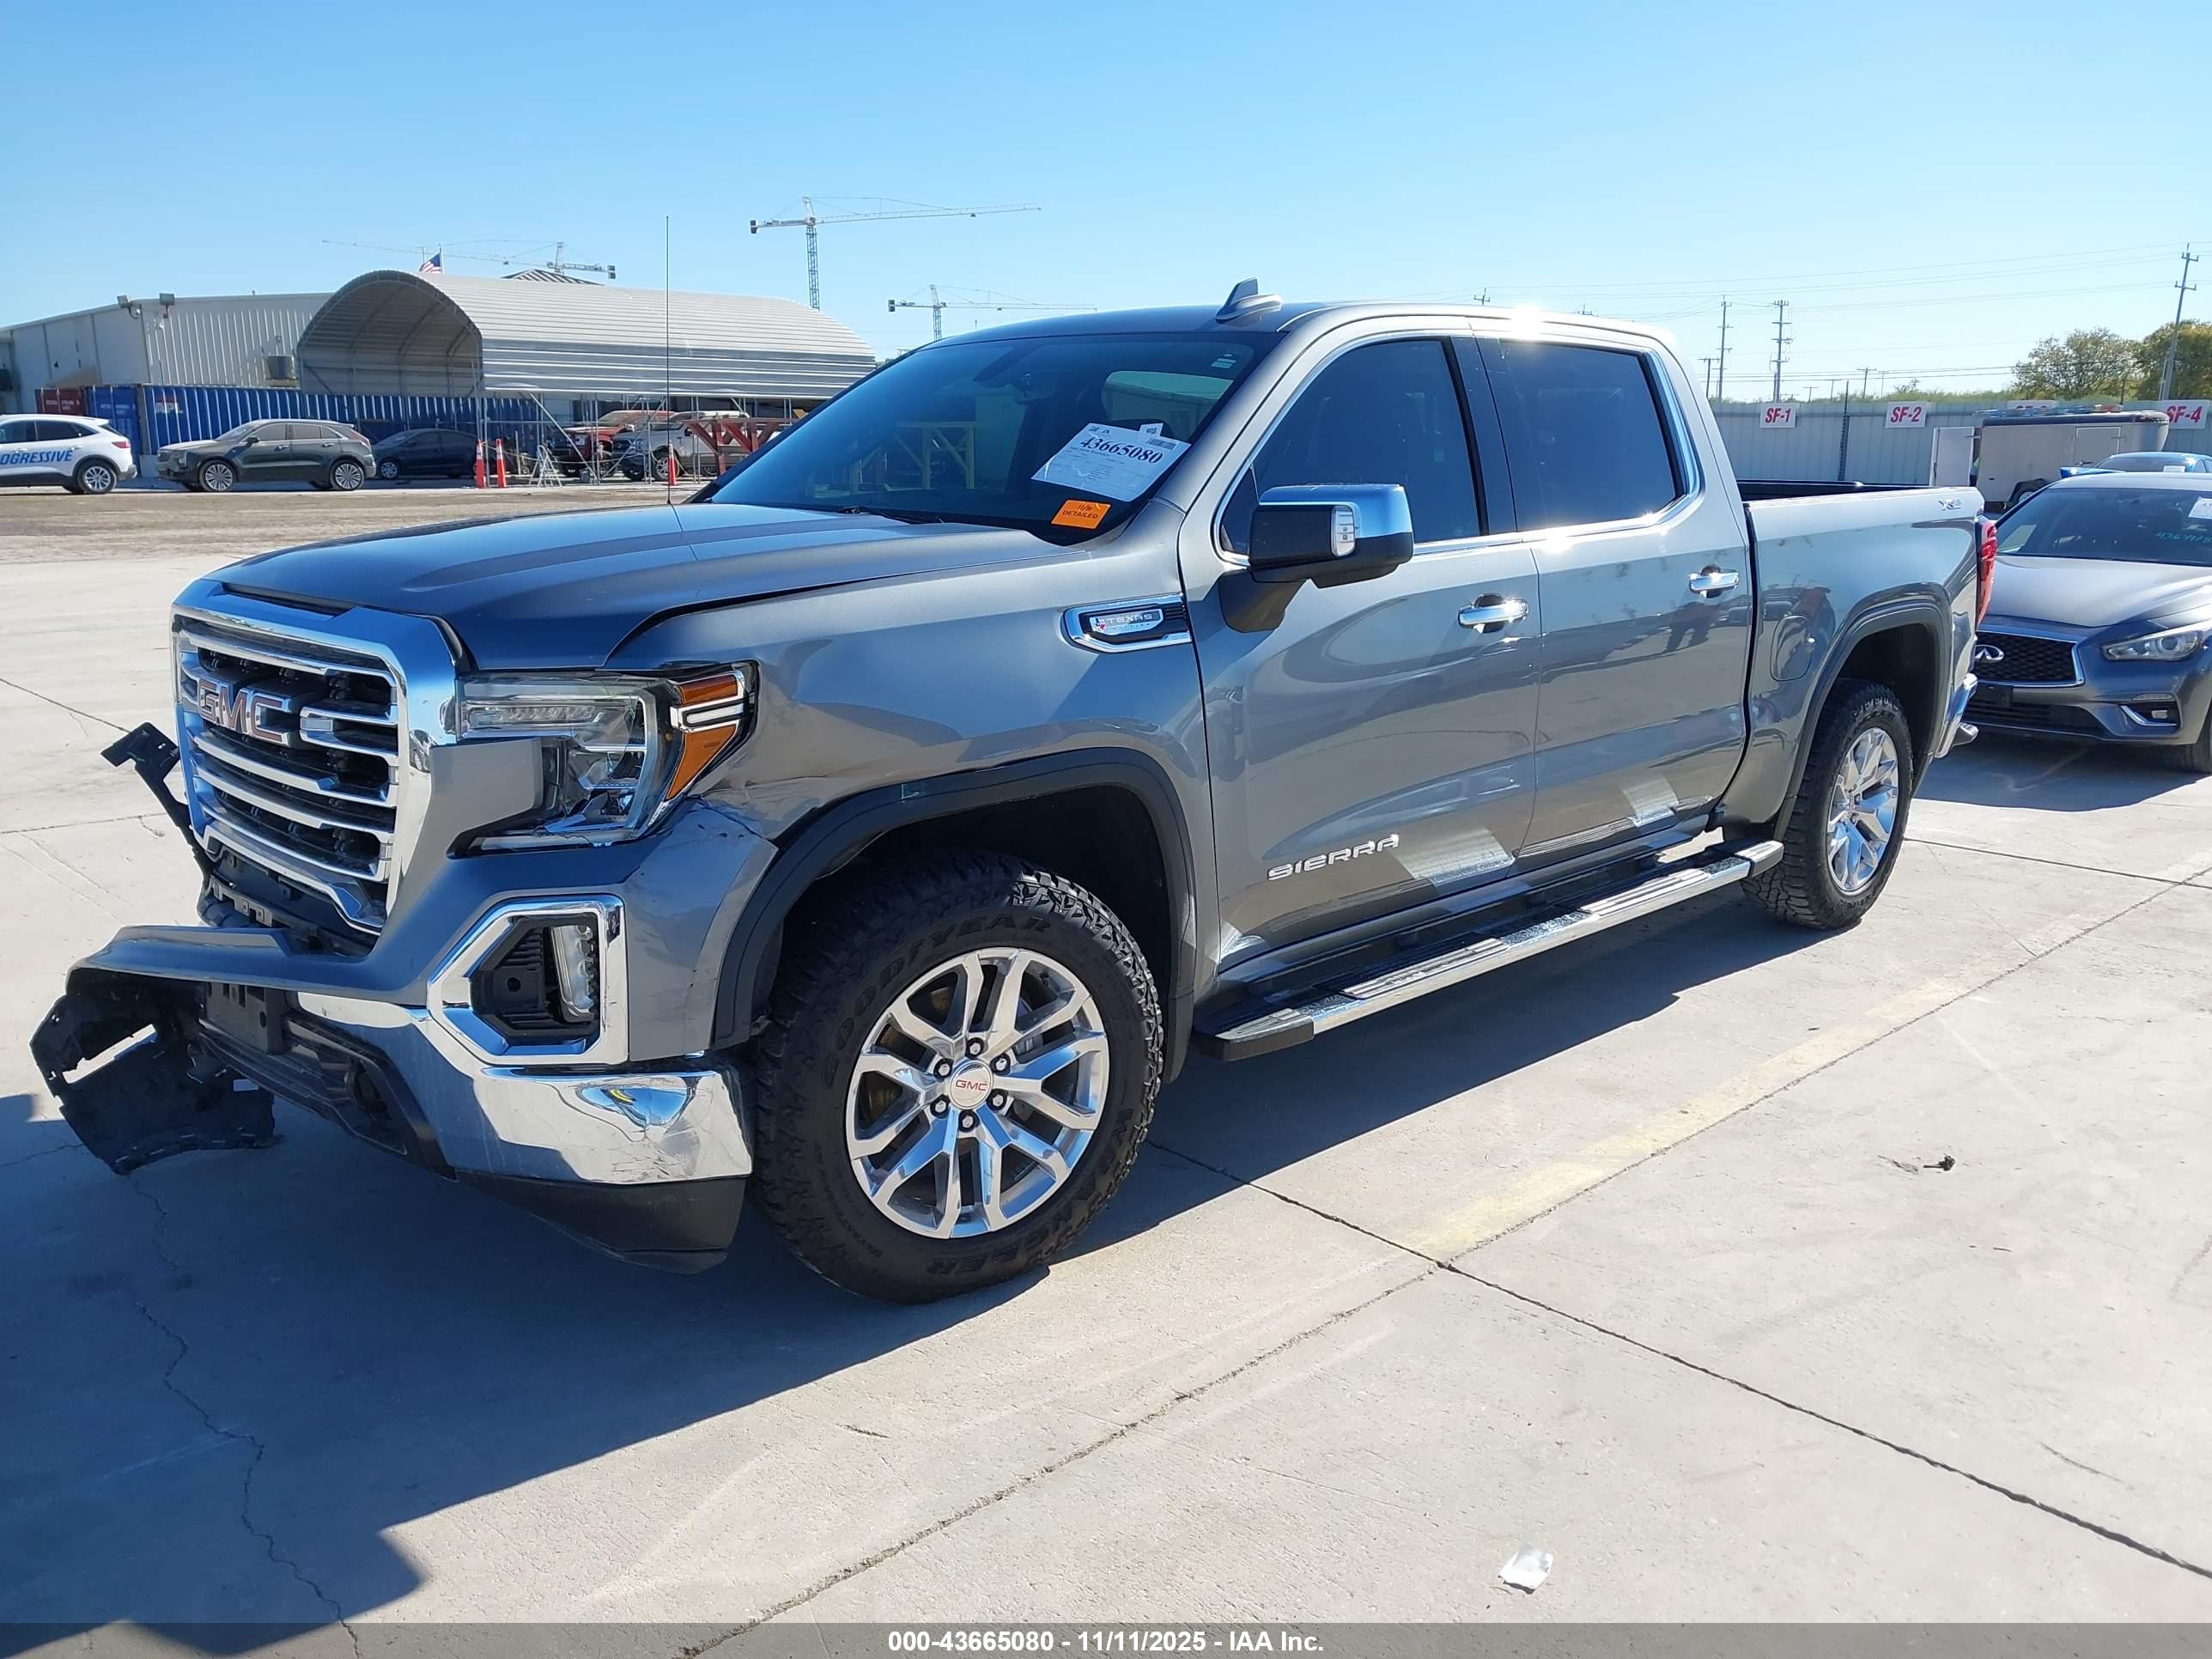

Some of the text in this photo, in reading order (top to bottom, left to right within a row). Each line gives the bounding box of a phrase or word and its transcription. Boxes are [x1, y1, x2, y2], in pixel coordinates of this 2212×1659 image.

[1765, 407, 1791, 422] SF-1
[1891, 406, 1922, 422] SF-2
[2166, 405, 2203, 423] SF-4
[1080, 436, 1163, 464] 43665080
[1061, 510, 1099, 519] DETAILED
[1106, 613, 1152, 624] TEXAS
[198, 678, 291, 746] GMC
[1267, 834, 1400, 881] SIERRA
[955, 1079, 988, 1091] GMC
